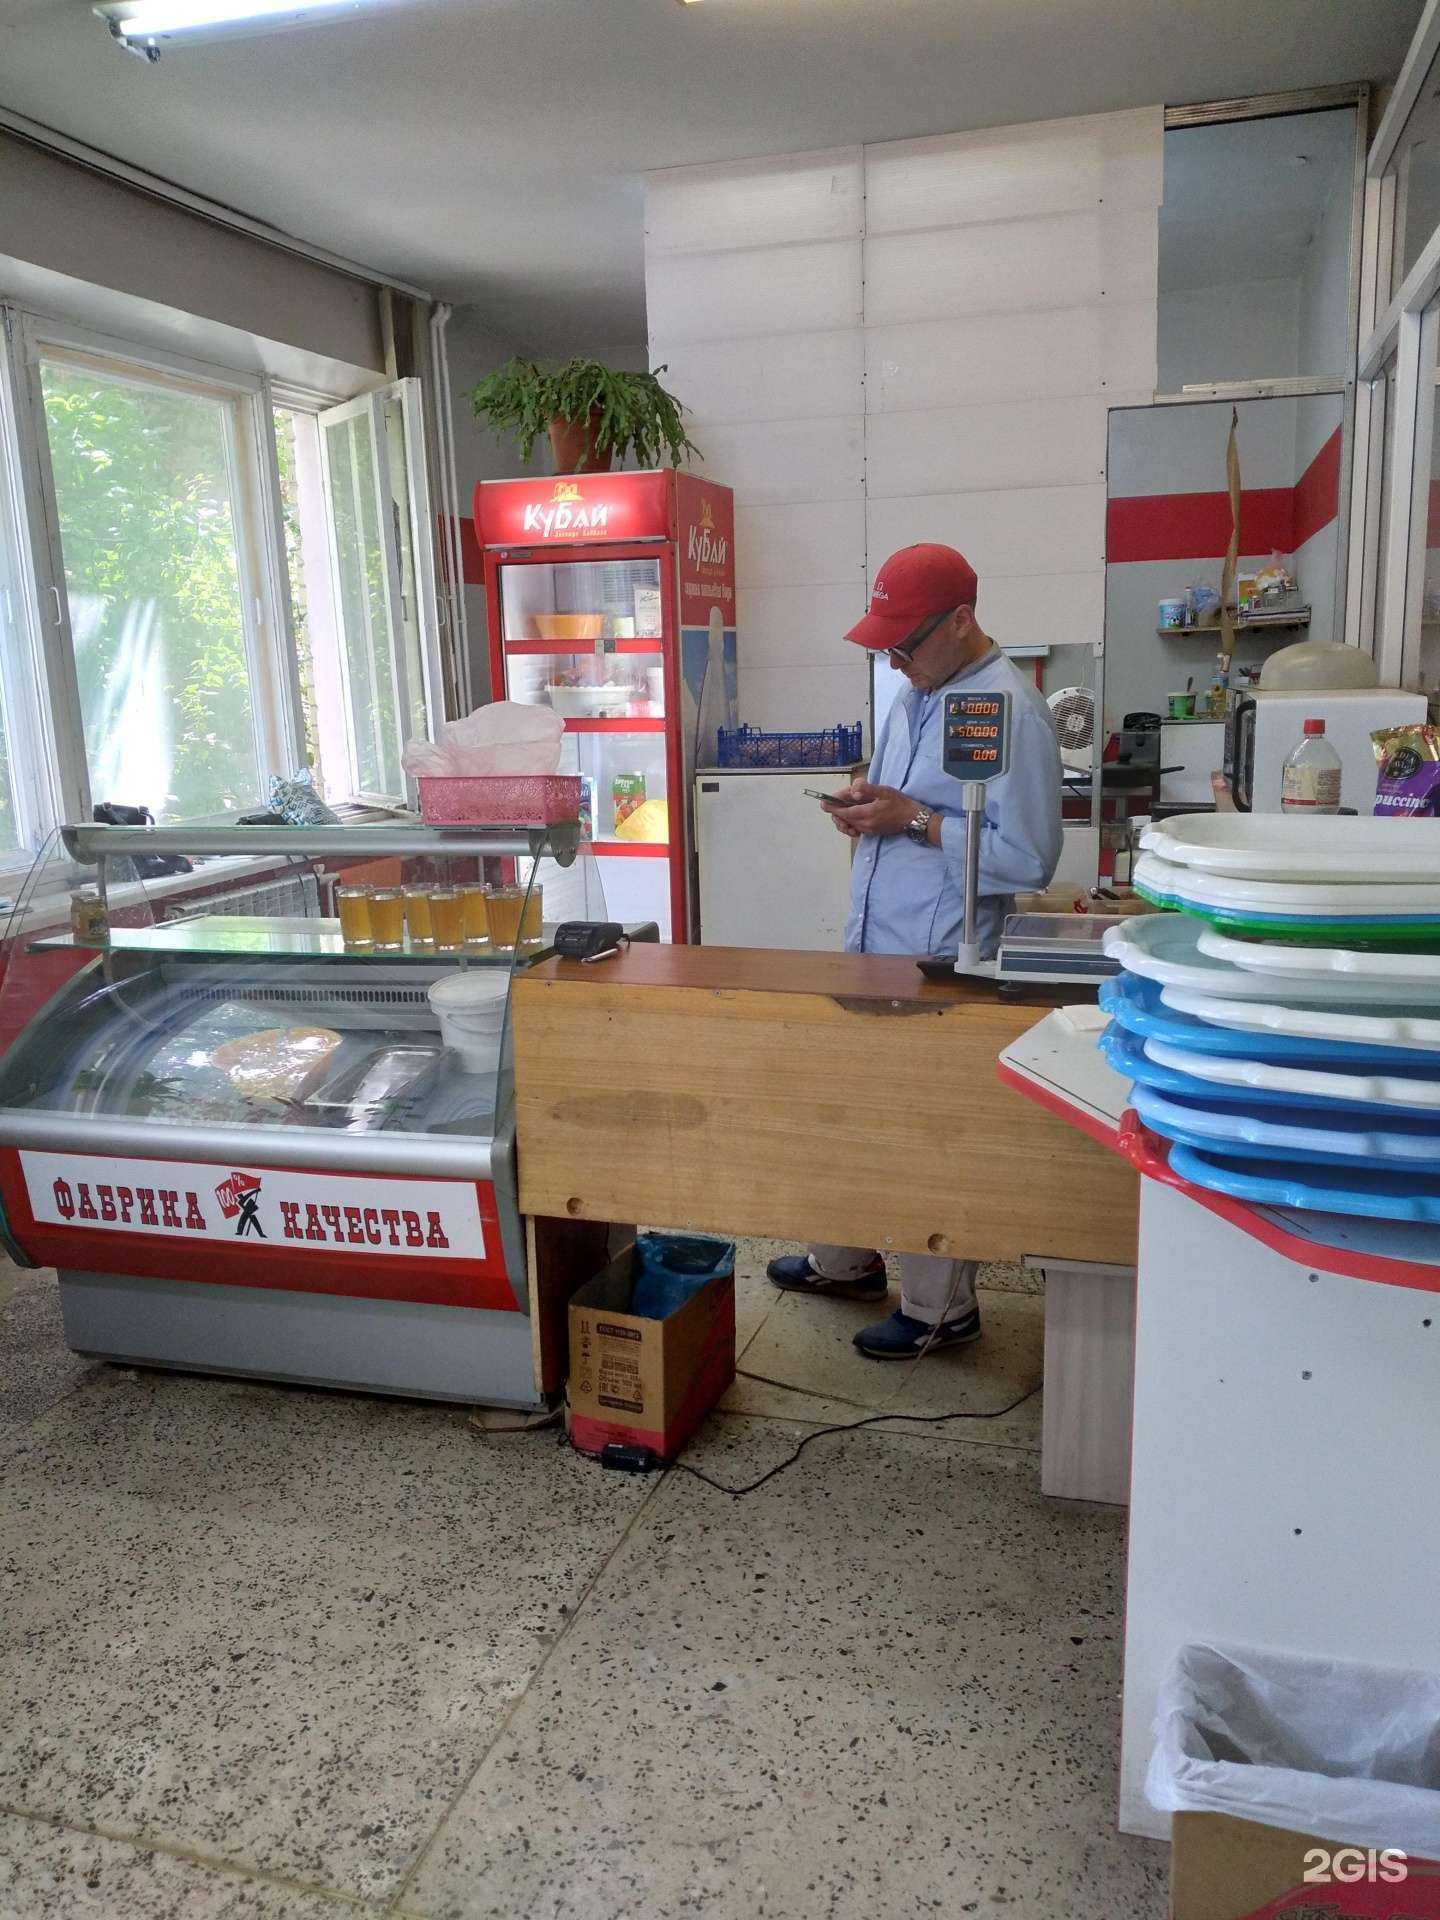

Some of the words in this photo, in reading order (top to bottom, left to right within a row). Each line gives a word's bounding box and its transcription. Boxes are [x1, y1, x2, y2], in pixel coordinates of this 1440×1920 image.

[872, 591, 889, 601] MEGA
[53, 1177, 207, 1230] ФАБРИКА
[279, 1201, 450, 1249] КАЧЕСТВА
